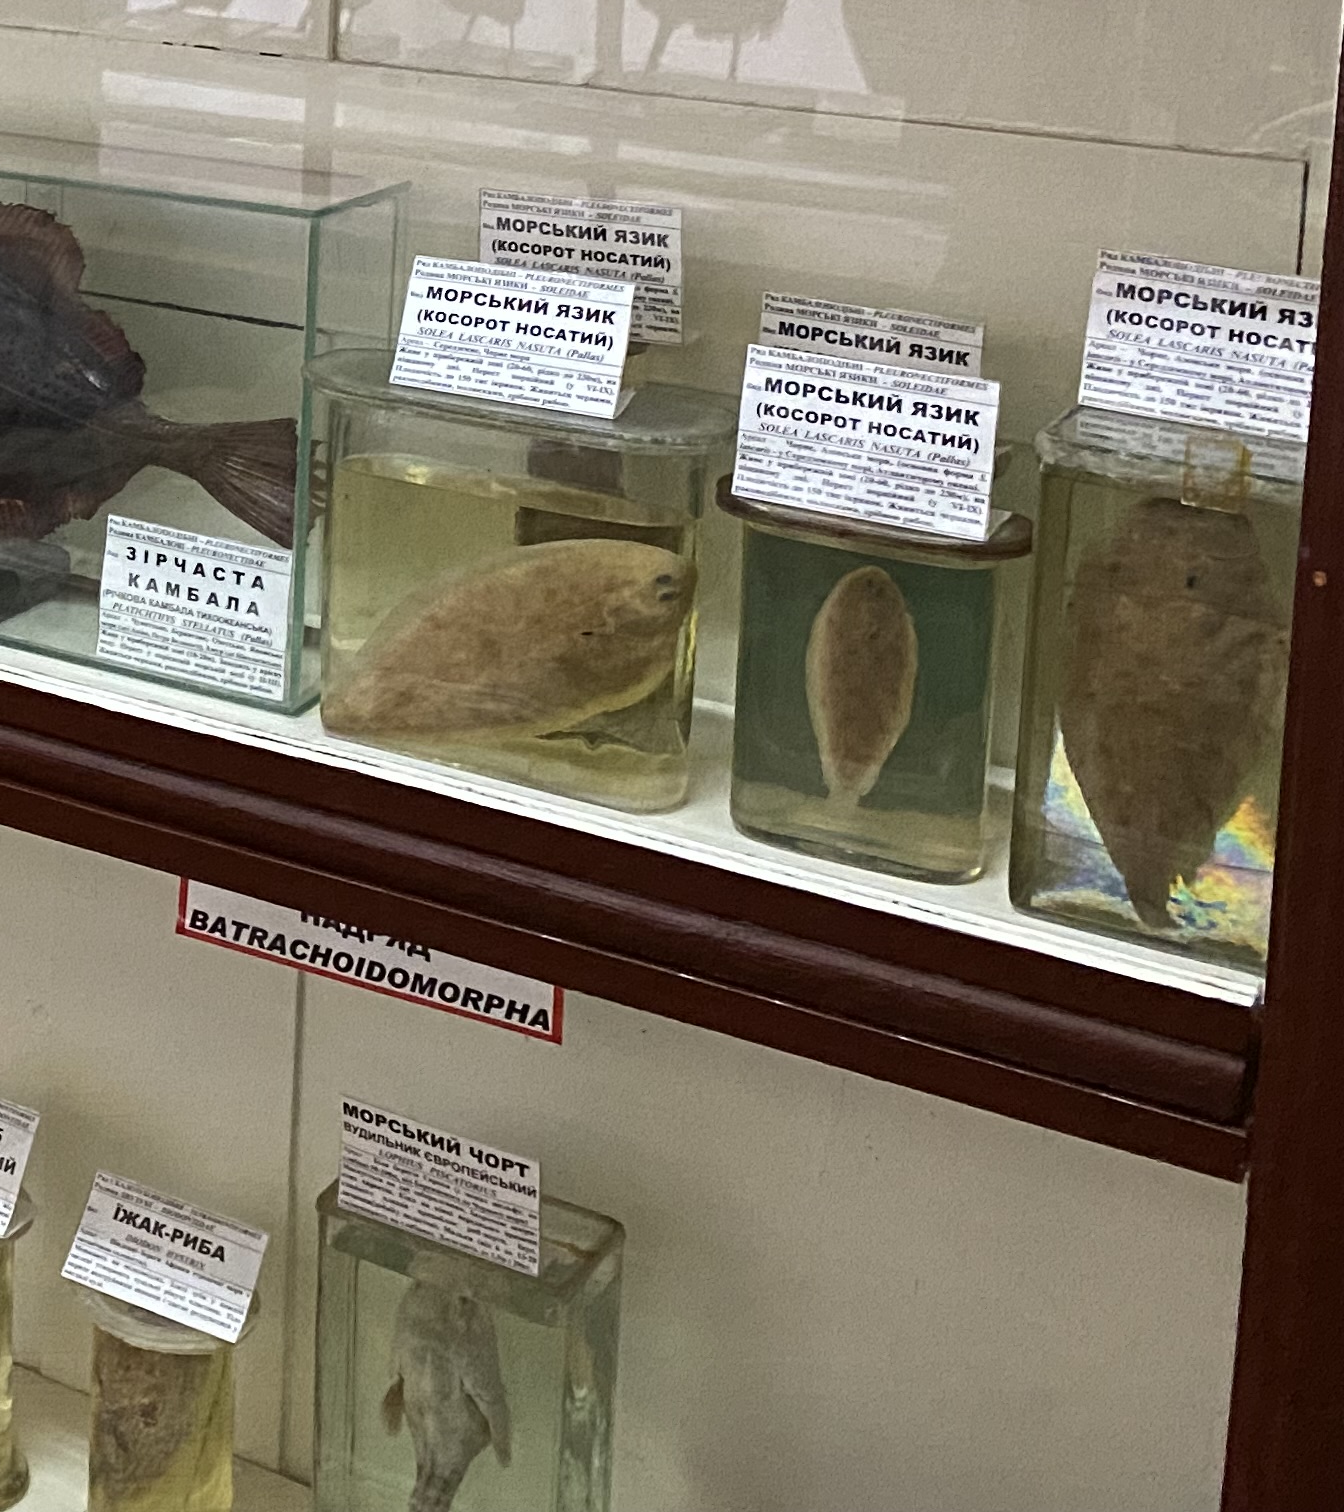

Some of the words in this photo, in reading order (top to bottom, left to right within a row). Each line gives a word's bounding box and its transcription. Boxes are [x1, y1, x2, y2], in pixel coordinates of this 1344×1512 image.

[496, 216, 607, 242] МОРСЬКИЙ
[614, 230, 669, 249] ЯЗИК
[492, 239, 575, 259] (КОСОРОТ
[581, 249, 671, 272] НОСАТИЙ)
[426, 286, 549, 316] МОРСЬКИЙ
[555, 304, 616, 325] ЯЗИК
[1116, 282, 1267, 321] МОРСЬКИЙ
[1277, 307, 1313, 328] ЯЗ
[417, 309, 511, 332] (КОСОРОТ
[515, 322, 614, 351] НОСАТИЙ)
[417, 326, 453, 339] SOLEA
[458, 332, 513, 348] LASCARIS
[518, 340, 562, 357] NASUTA
[566, 347, 605, 363] (Pallas)
[778, 321, 901, 355] МОРСЬКИЙ
[908, 343, 970, 367] ЯЗИК
[1107, 309, 1221, 339] (КОСОРОТ
[1229, 329, 1315, 354] НОСАТ
[1107, 329, 1150, 345] SOLEA
[1232, 350, 1287, 369] NASUTA
[764, 377, 902, 413] МОРСЬКИЙ
[911, 401, 980, 426] ЯЗИК
[756, 402, 862, 431] (КОСОРОТ
[867, 421, 980, 454] НОСАТИЙ)
[758, 422, 799, 439] SOLEA
[804, 429, 865, 448] LASCARIS
[871, 441, 921, 459] NASUTA
[126, 546, 265, 591] ЗІРЧАСТА
[128, 572, 260, 616] КАМБАЛА
[188, 908, 551, 1031] BATRACHOIDOMORPHA
[343, 1102, 461, 1156] МОРСЬКИЙ
[469, 1146, 531, 1178] ЧОРТ
[343, 1121, 422, 1158] ВУДИЛЬНИК
[424, 1151, 538, 1198] ЄВРОПЕЙСЬКИЙ
[112, 1203, 225, 1263] ЇЖАК-РИБА
